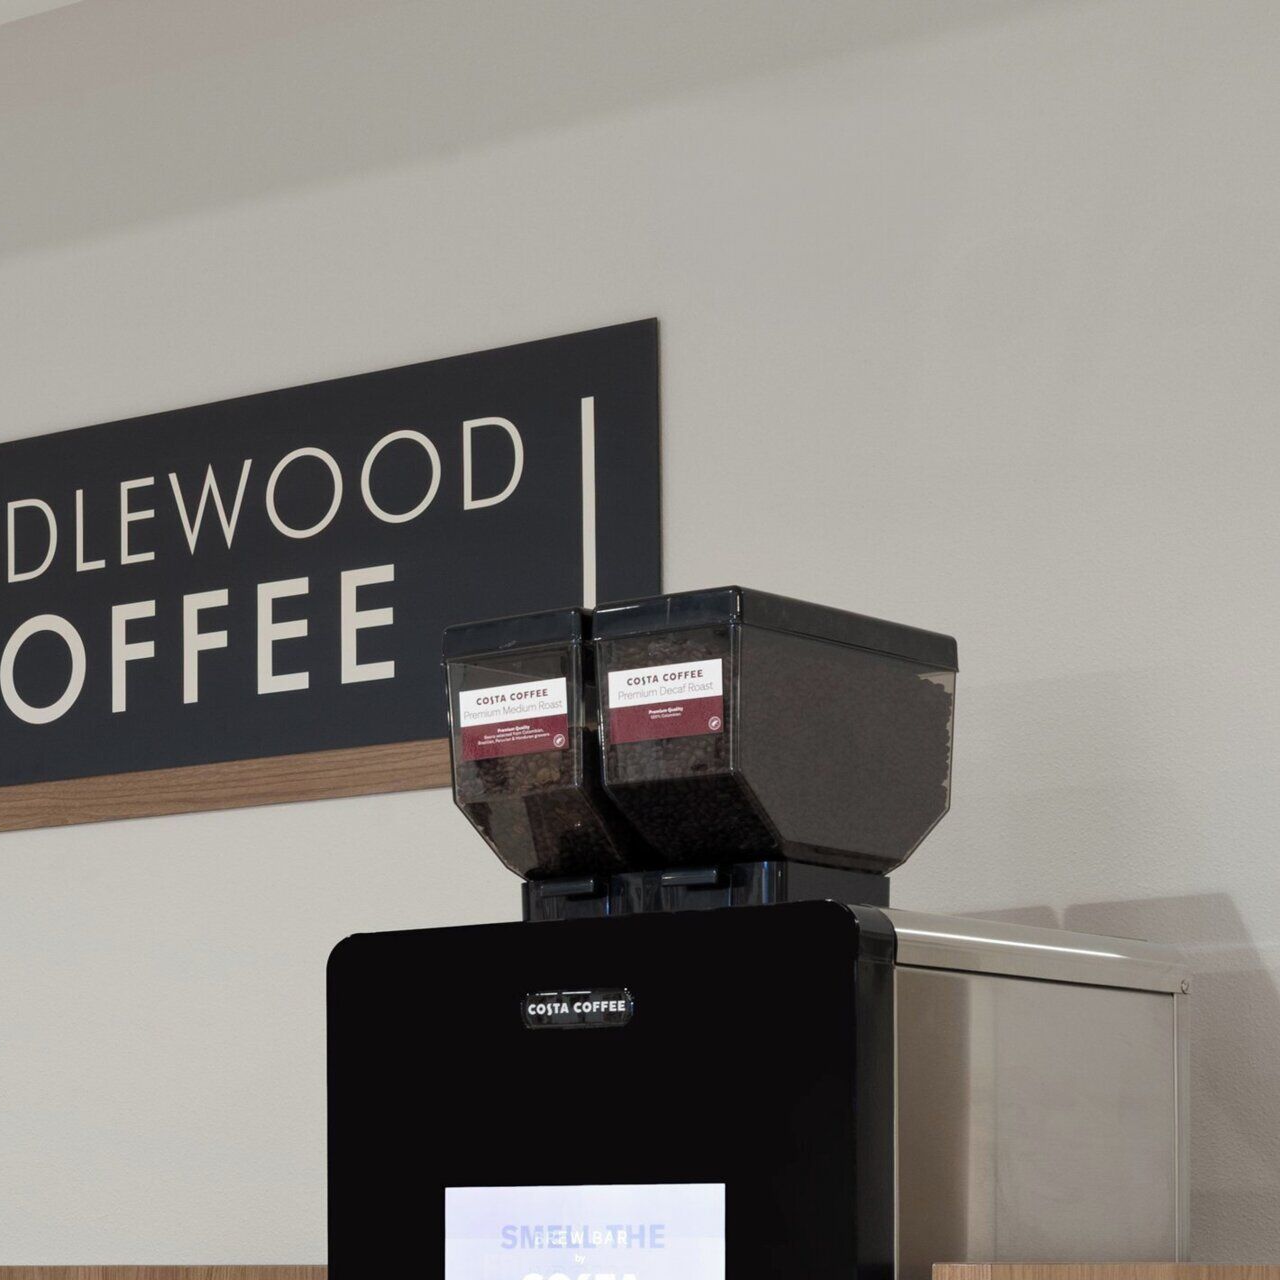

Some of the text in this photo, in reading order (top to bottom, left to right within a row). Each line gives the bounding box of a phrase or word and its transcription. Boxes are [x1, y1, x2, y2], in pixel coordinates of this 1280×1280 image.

[627, 669, 703, 686] COSTA COFFEE
[476, 688, 548, 706] COSTA COFFEE
[618, 681, 714, 701] Premium Decaf Roast
[464, 699, 562, 720] Premium Medium Roast
[527, 999, 626, 1017] COSTA COFFEE
[500, 1223, 666, 1249] SMELL THE
